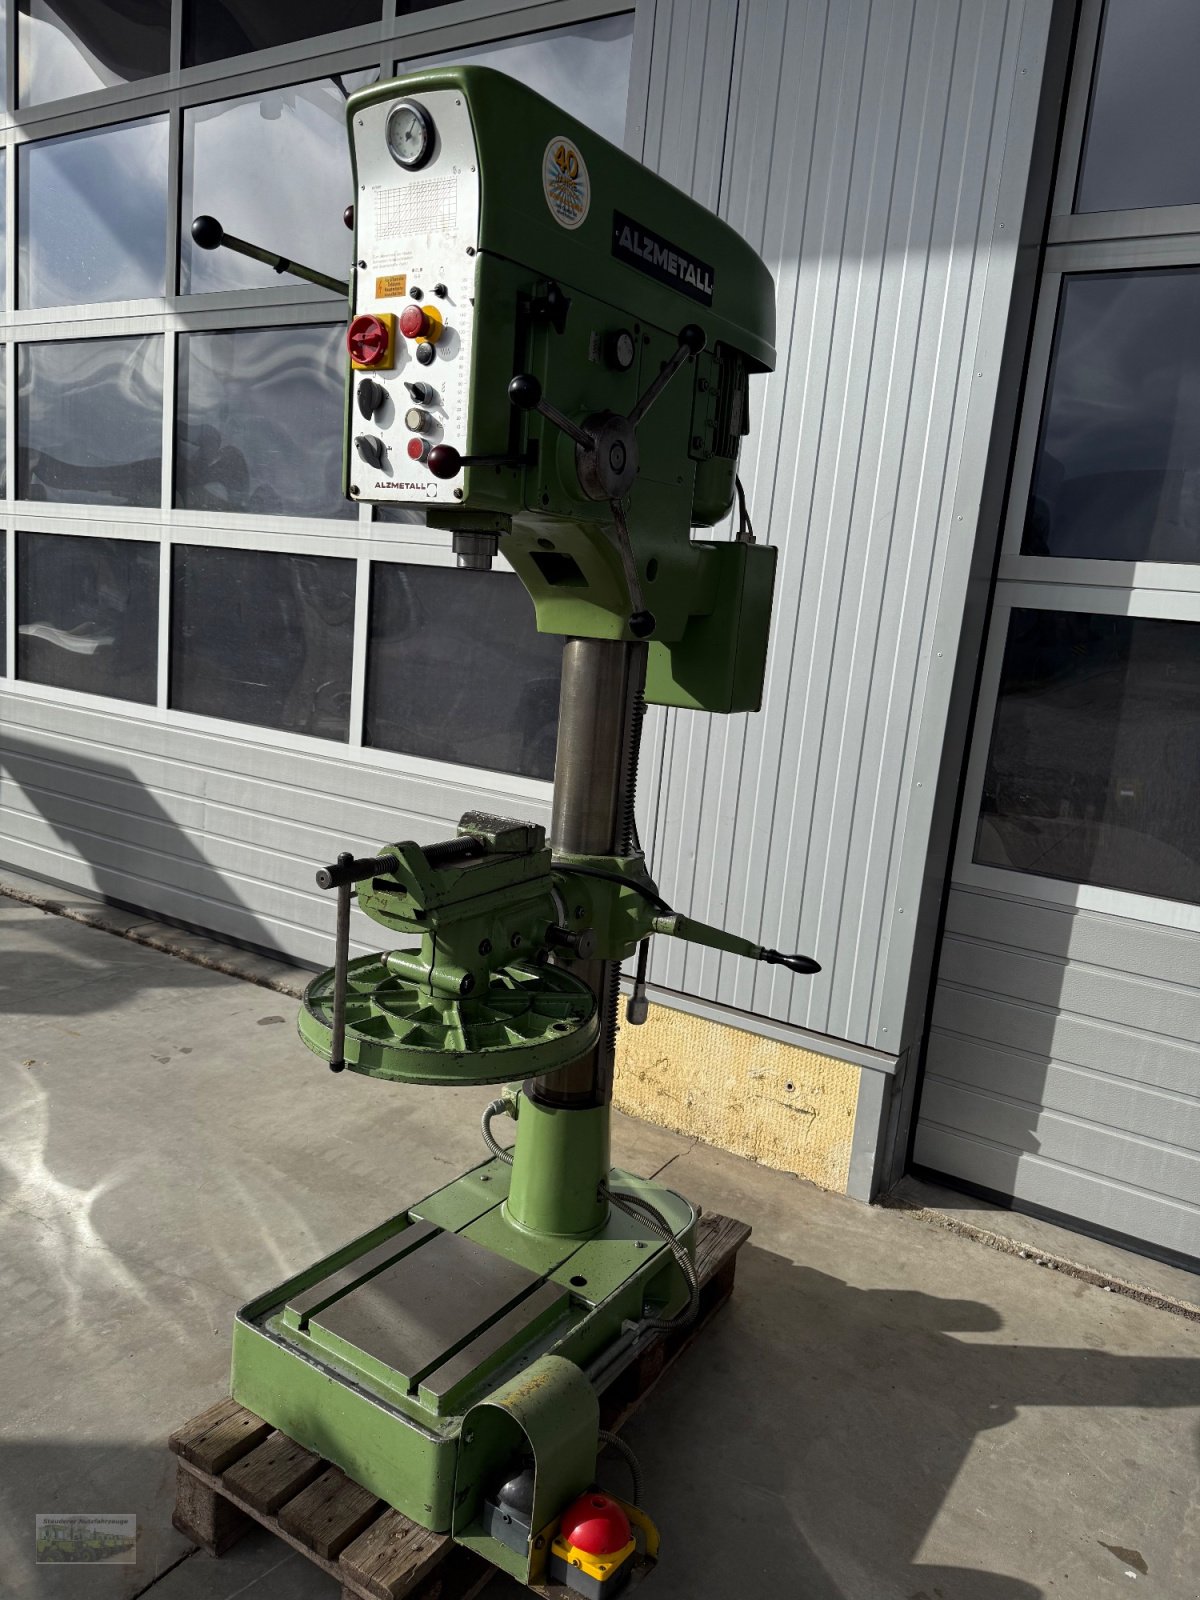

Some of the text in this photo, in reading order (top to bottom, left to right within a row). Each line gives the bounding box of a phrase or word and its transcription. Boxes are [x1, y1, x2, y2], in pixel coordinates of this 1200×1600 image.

[554, 145, 579, 180] 40
[619, 226, 712, 295] ALZMETALL
[374, 482, 426, 490] ALZMETALL
